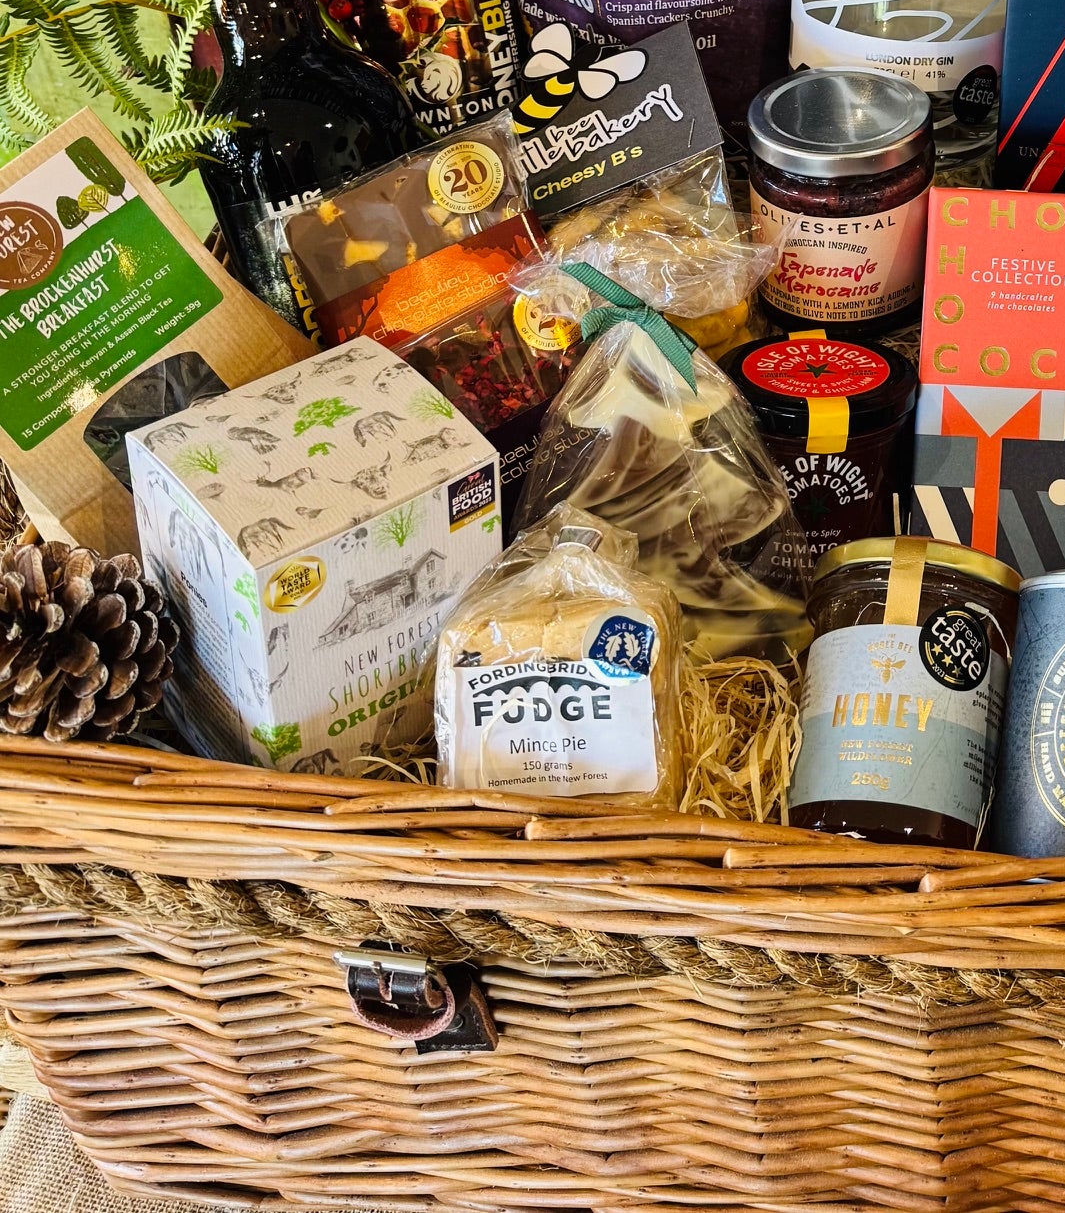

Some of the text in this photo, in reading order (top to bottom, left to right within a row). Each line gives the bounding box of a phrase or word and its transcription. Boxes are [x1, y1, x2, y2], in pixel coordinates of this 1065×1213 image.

[605, 2, 632, 13] Crisp
[634, 1, 653, 11] and
[606, 5, 735, 26] Spanish Crackers. Crunchy.
[866, 51, 954, 66] LONDON DRY GIN
[925, 70, 946, 79] 41%
[562, 84, 684, 161] bakery
[532, 159, 607, 201] Cheesy
[20, 237, 120, 319] BROCKENHURST
[990, 257, 1056, 273] FESTIVE
[36, 275, 110, 339] BREAKFAST
[372, 270, 508, 343] chocolate studio
[395, 272, 470, 312] beaulieu
[987, 302, 1056, 313] fine chocolates
[990, 291, 1055, 303] 9 handcrafted
[3, 265, 172, 396] A STRONGER BREAKFAST BLEND TO GET
[931, 616, 982, 681] taste
[473, 694, 613, 727] FUDGE
[832, 692, 936, 732] HONEY
[510, 737, 587, 755] Mince Pie
[522, 761, 573, 772] 150 grams
